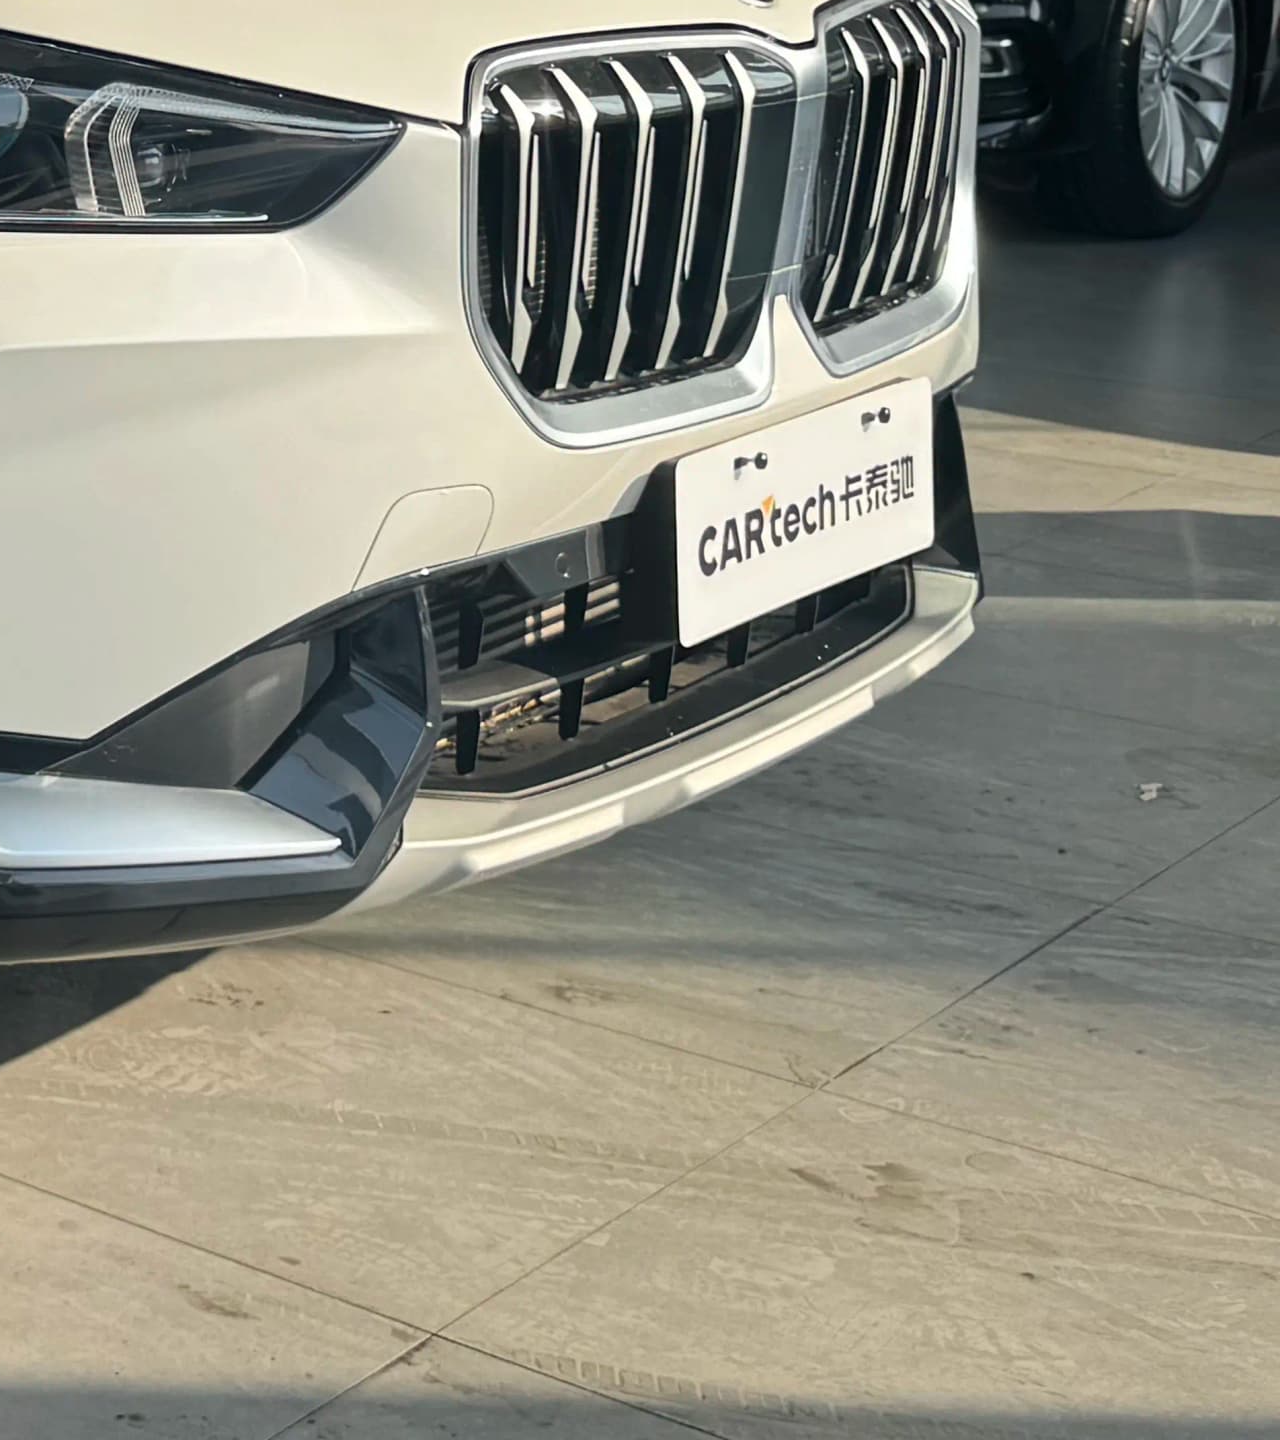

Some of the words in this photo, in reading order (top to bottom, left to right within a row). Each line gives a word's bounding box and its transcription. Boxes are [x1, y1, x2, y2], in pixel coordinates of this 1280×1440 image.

[698, 483, 836, 577] CARtech
[840, 455, 915, 522] 卡泰驰
